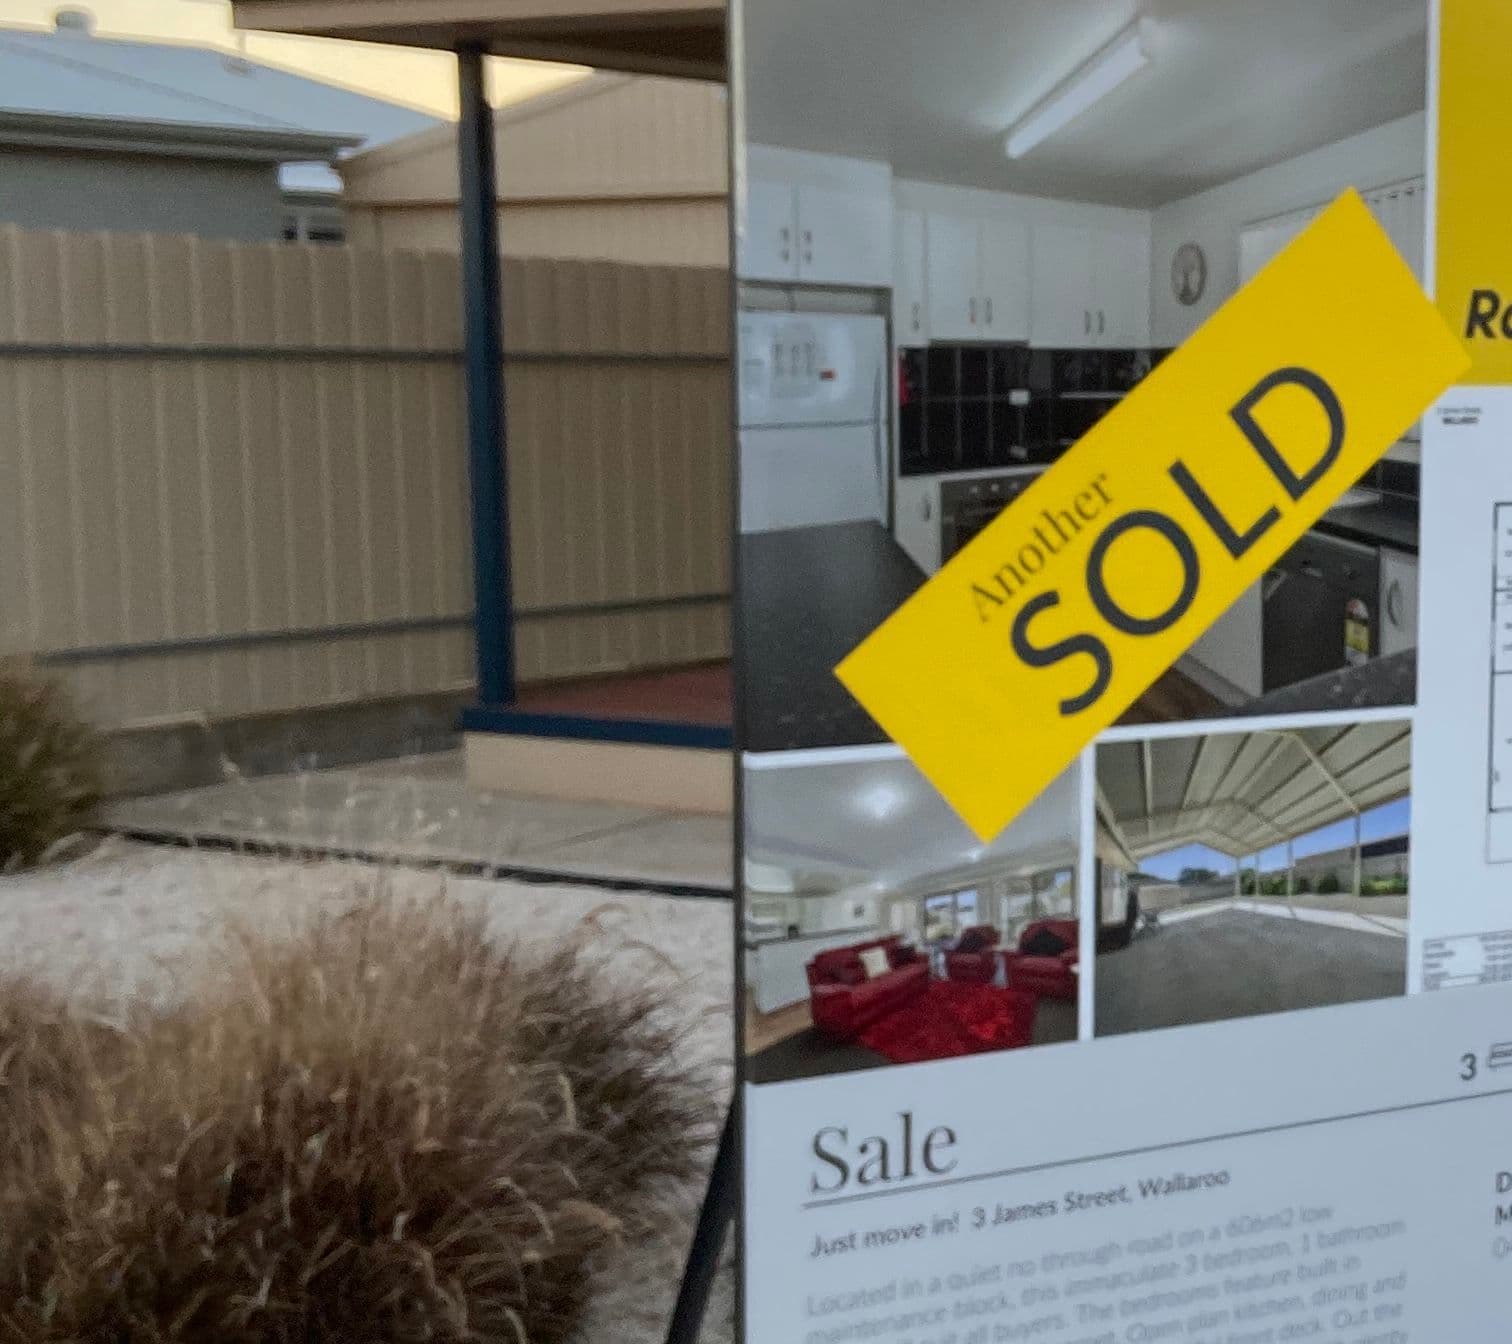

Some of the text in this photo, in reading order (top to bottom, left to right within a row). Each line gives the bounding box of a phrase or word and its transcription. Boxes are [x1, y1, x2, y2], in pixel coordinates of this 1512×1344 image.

[969, 472, 1114, 623] Another
[1010, 366, 1346, 718] SOLD
[1459, 1052, 1478, 1081] 3
[810, 1109, 959, 1194] Sale
[810, 1229, 857, 1258] Just
[864, 1222, 926, 1247] move
[931, 1210, 961, 1234] in!
[970, 1206, 987, 1230] 3
[992, 1202, 1058, 1226] James
[1137, 1169, 1231, 1199] Wallaroo
[805, 1279, 896, 1317] Located
